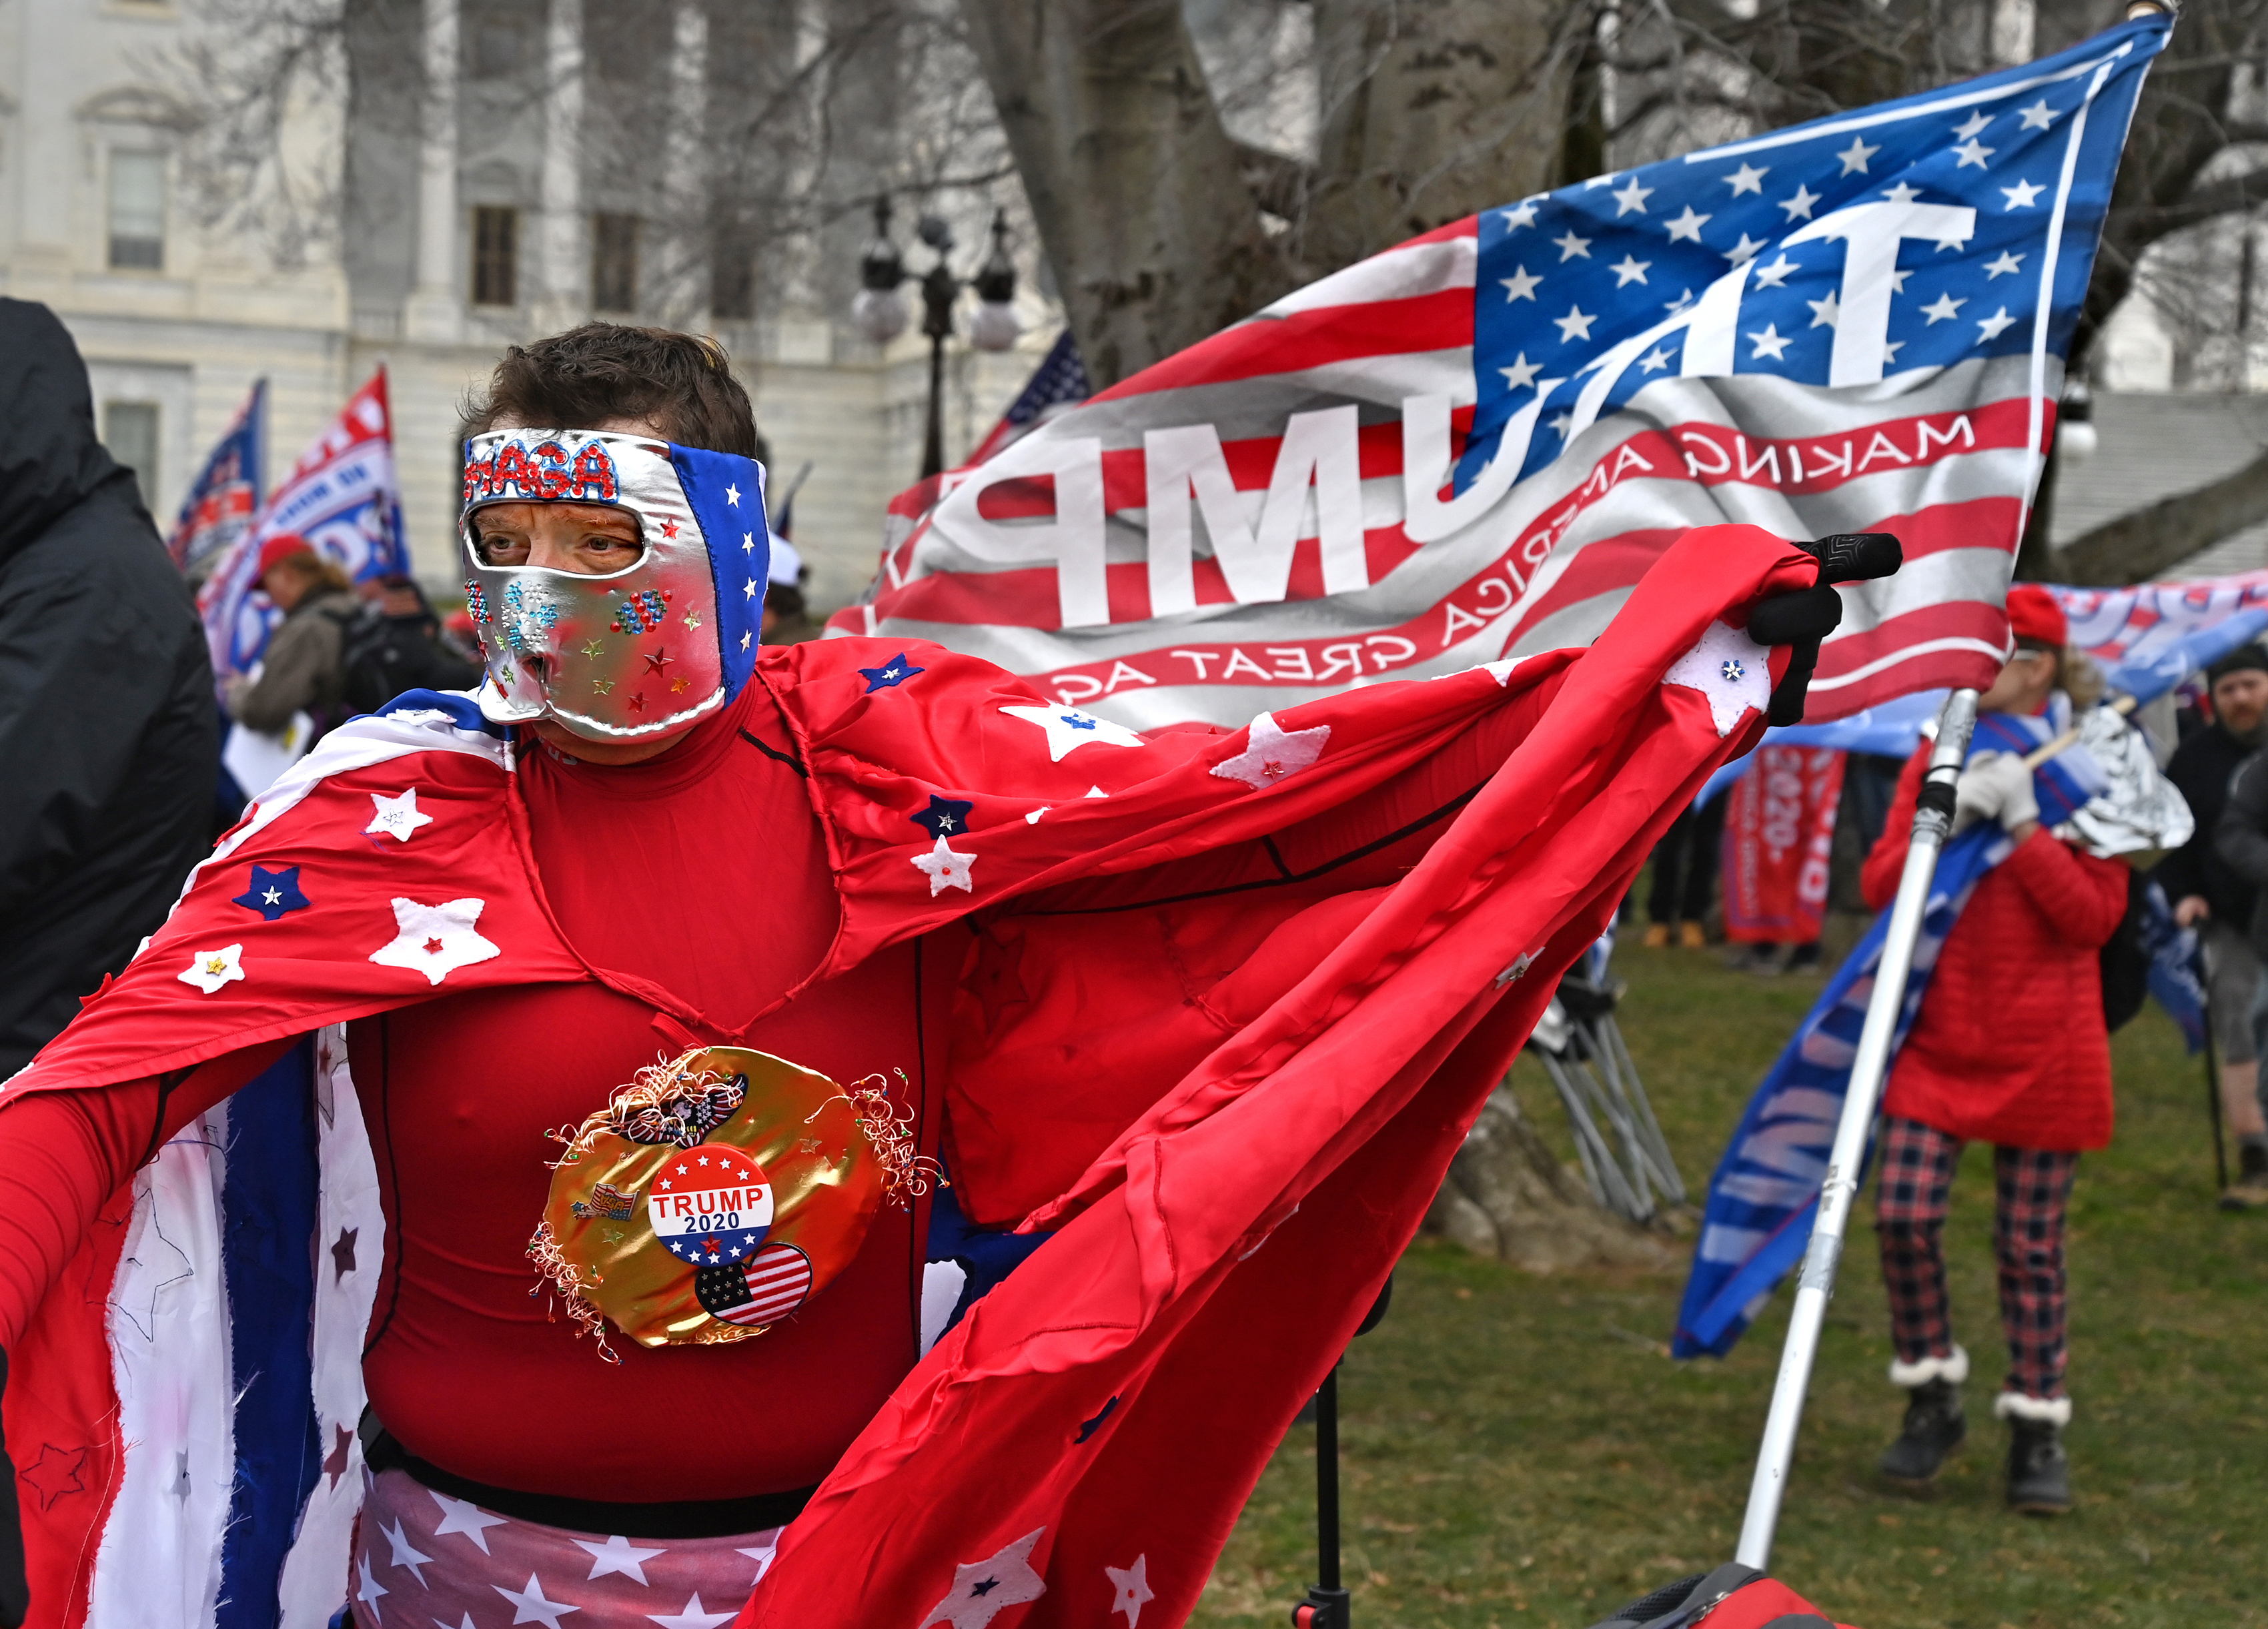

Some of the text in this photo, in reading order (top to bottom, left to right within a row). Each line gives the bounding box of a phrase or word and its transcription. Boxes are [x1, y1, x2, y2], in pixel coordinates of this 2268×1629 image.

[600, 1193, 625, 1211] USA
[652, 1187, 763, 1218] TRUMP
[684, 1212, 740, 1233] 2020
